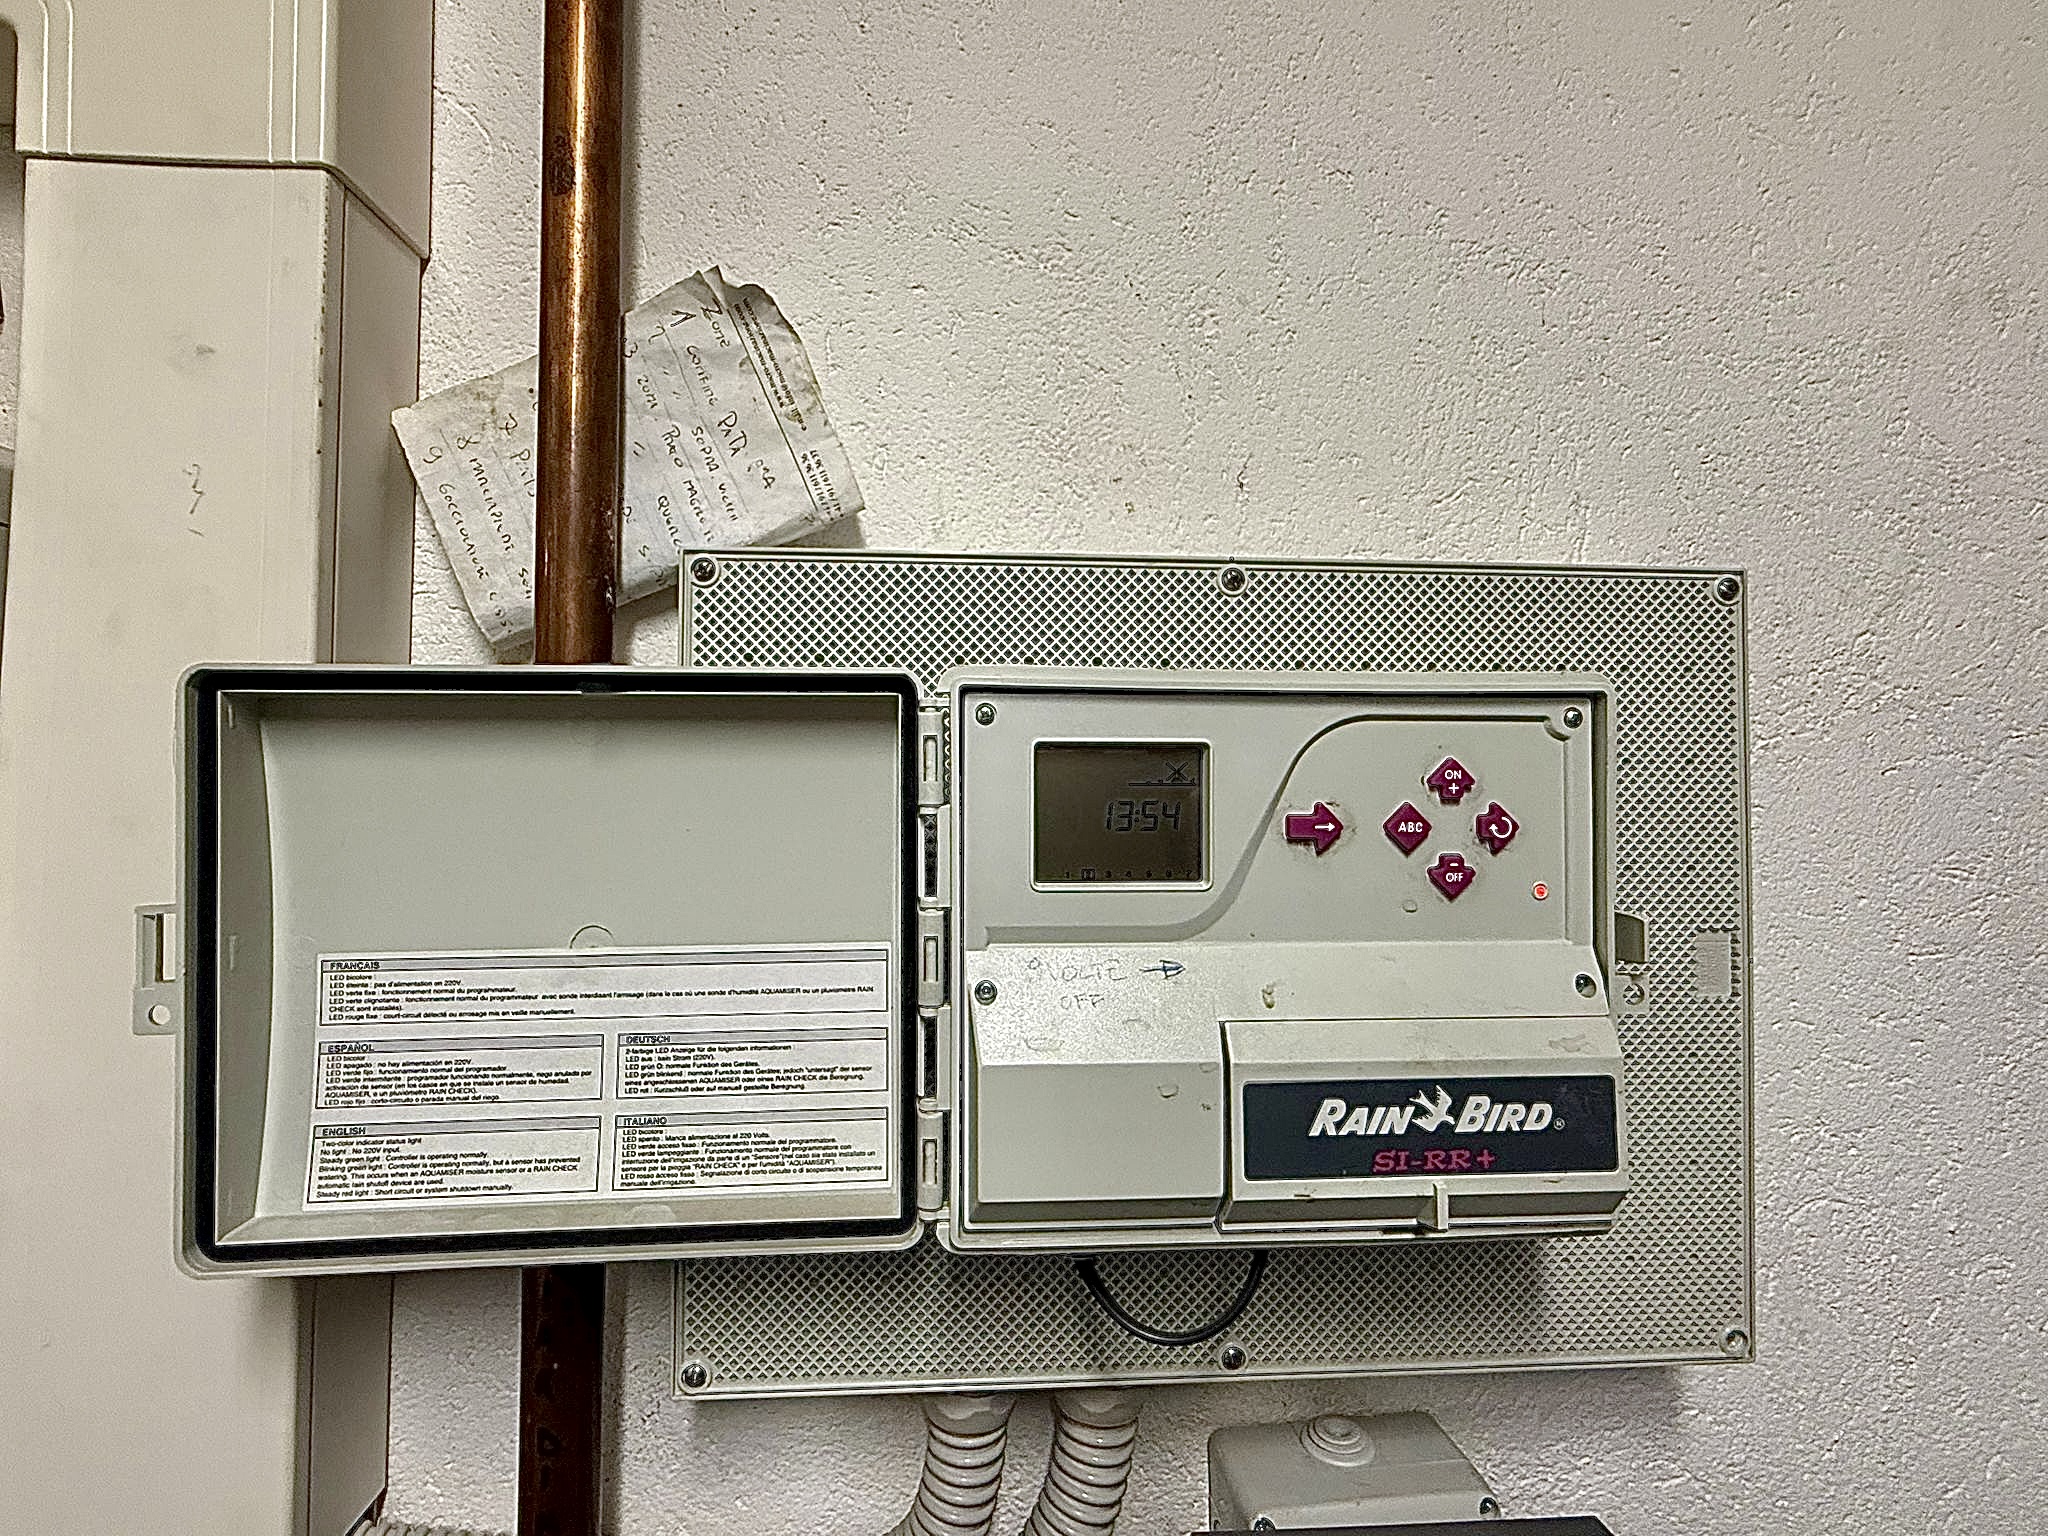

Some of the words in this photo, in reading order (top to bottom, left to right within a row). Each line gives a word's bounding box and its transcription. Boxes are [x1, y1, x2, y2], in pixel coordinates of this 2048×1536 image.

[1444, 769, 1462, 781] ON
[1106, 800, 1181, 832] 13:54
[1398, 821, 1424, 834] ABC
[1445, 872, 1464, 884] OFF
[329, 961, 380, 970] FRANÇAIS
[625, 1034, 671, 1043] DEUTSCH
[326, 1042, 374, 1053] ESPAÑOL
[623, 1116, 668, 1125] ITALIANO
[1308, 1099, 1416, 1137] RAIN
[1454, 1095, 1554, 1133] BIRD
[321, 1126, 366, 1136] ENGLISH
